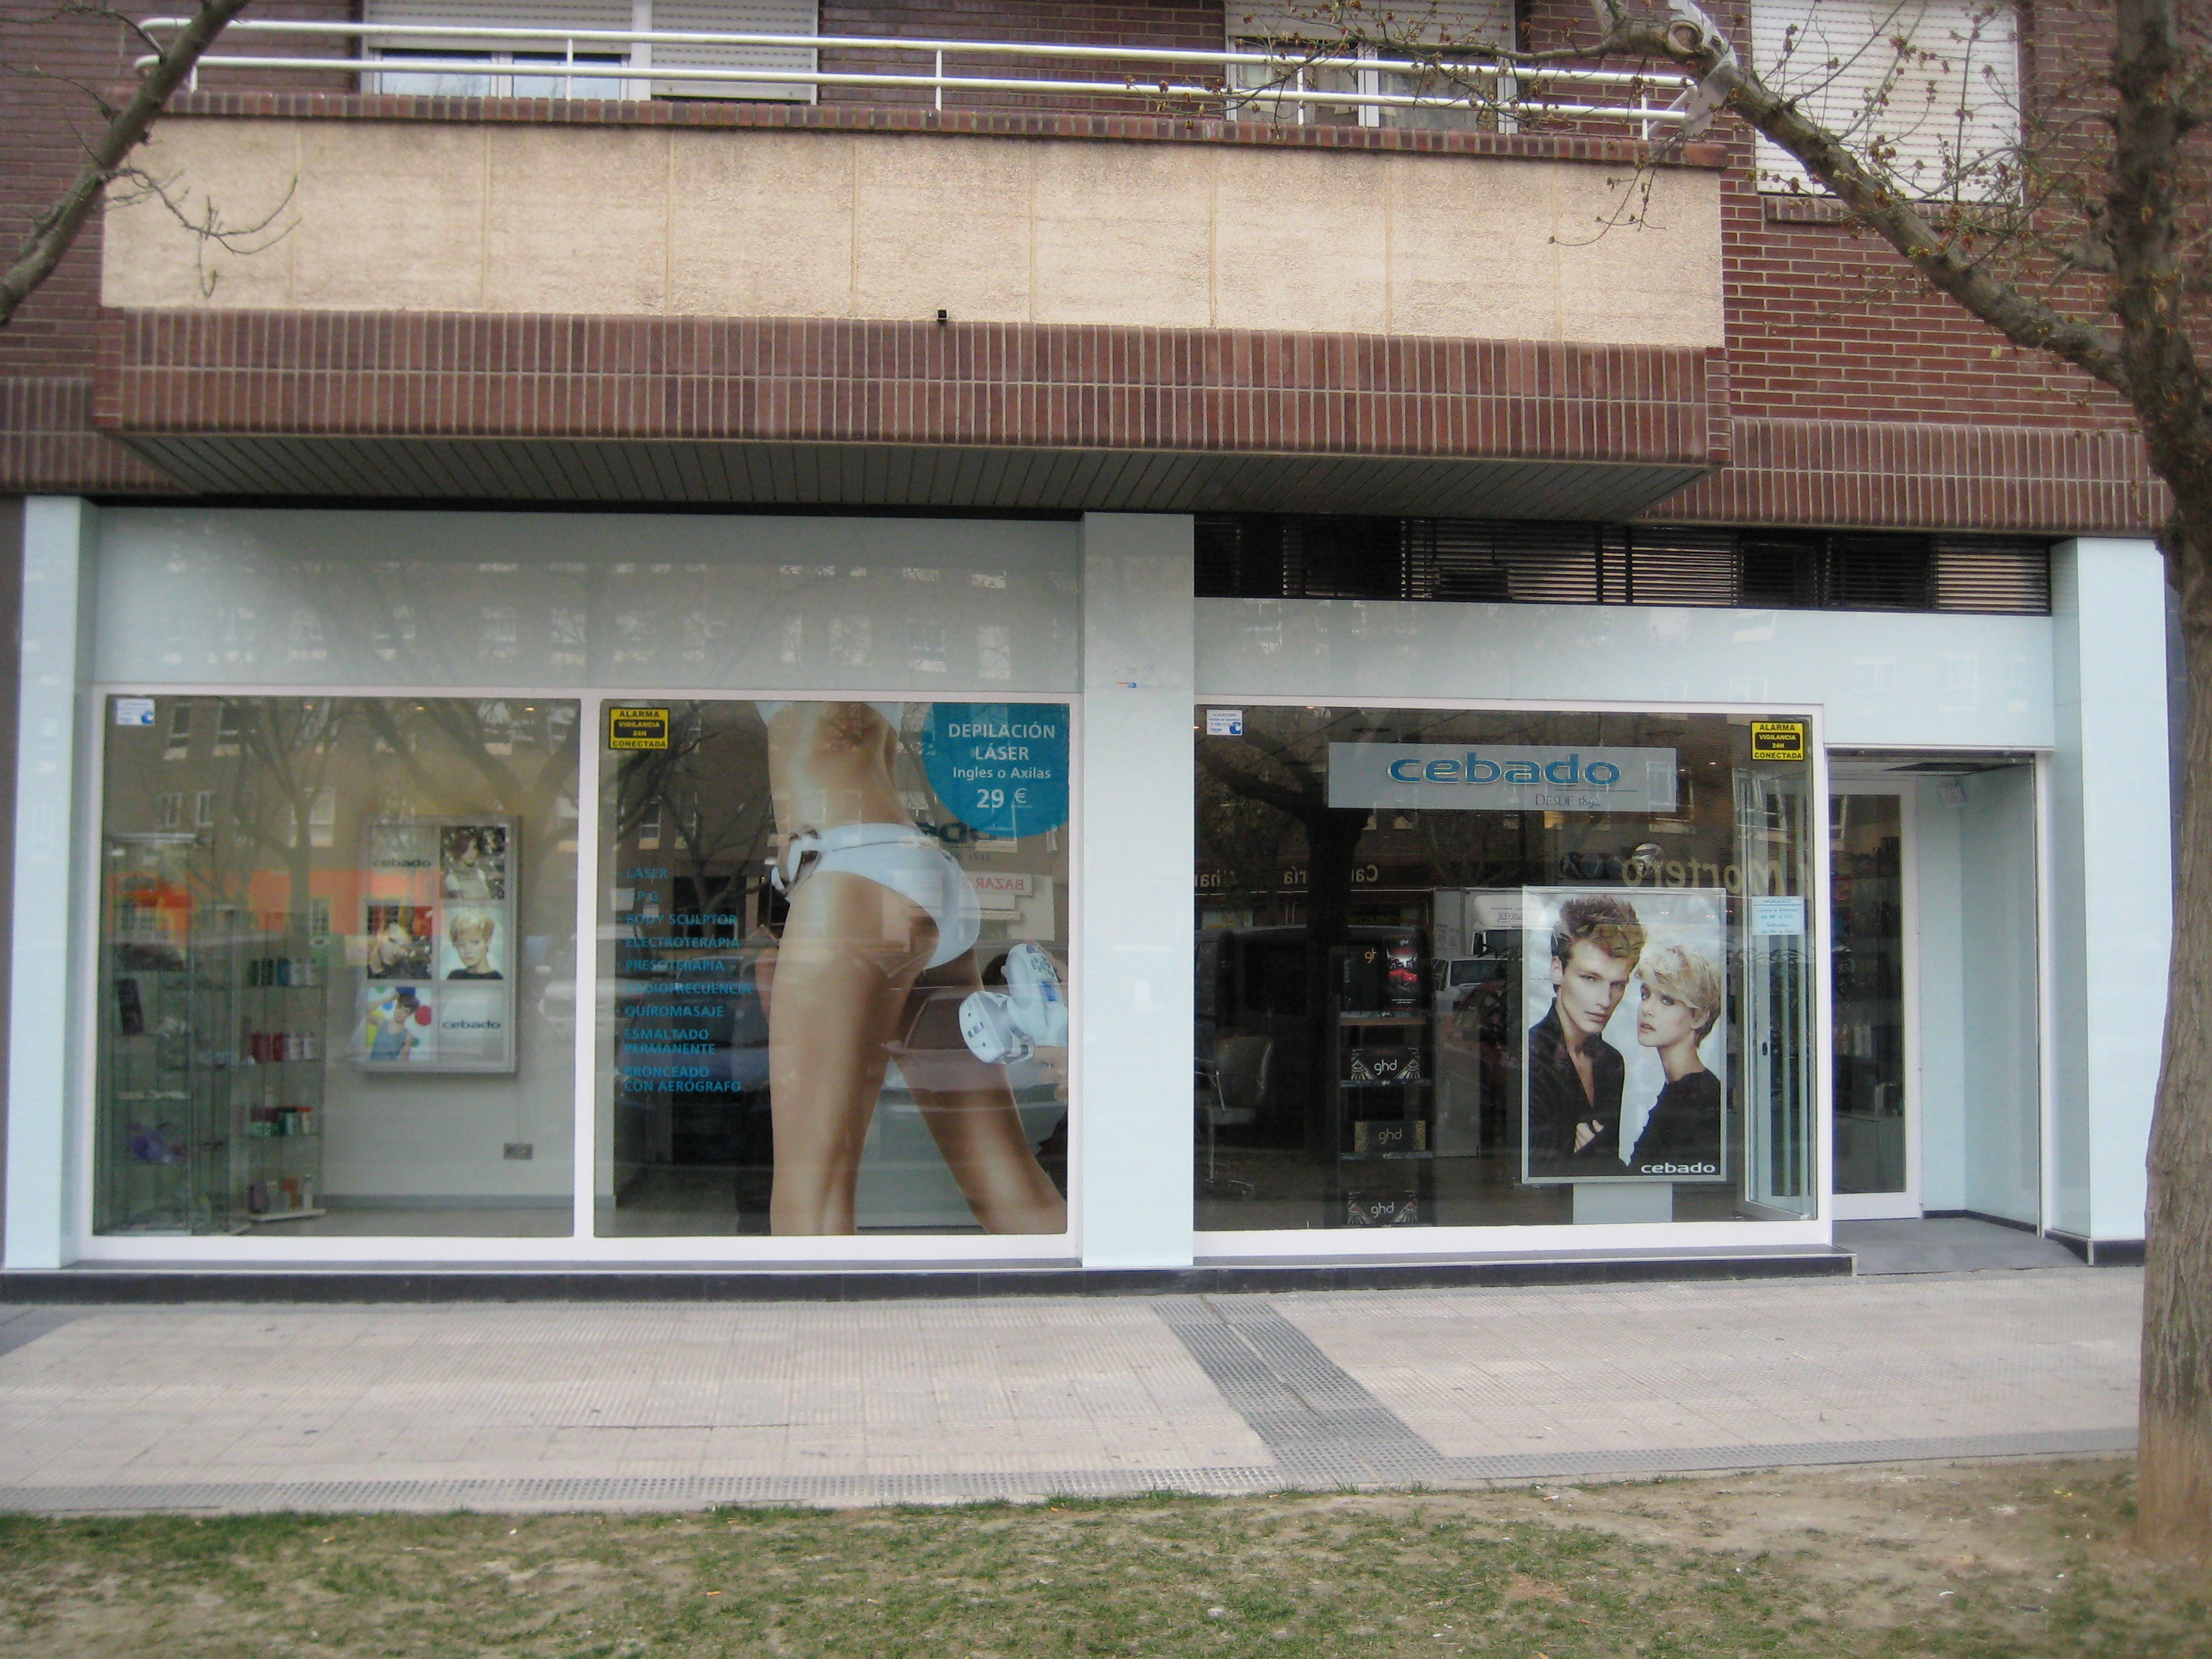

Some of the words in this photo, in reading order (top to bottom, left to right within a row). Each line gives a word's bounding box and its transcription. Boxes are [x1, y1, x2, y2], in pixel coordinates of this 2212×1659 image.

[948, 721, 1056, 739] DEPILACIÓN
[974, 742, 1030, 761] LÁSER
[953, 766, 993, 781] Ingles
[997, 770, 1006, 778] o
[1010, 767, 1051, 779] Axilas
[1387, 751, 1622, 786] cebado
[976, 788, 1005, 809] 29
[1014, 788, 1028, 804] €
[626, 914, 665, 925] BODY
[668, 914, 739, 926] SCULPTOR
[624, 981, 752, 995] RADIOFRECUENCIA
[441, 1020, 502, 1030] cebado
[624, 1028, 710, 1040] ESMALTADO
[624, 1043, 716, 1055] PERMANENTE
[624, 1066, 711, 1078] BRONCEADO
[1373, 1058, 1398, 1076] ghd
[624, 1081, 654, 1092] CON
[657, 1078, 743, 1093] AERÓGRAFO
[1378, 1128, 1402, 1145] ghd
[1640, 1161, 1716, 1174] cebado
[1370, 1201, 1395, 1219] ghd
